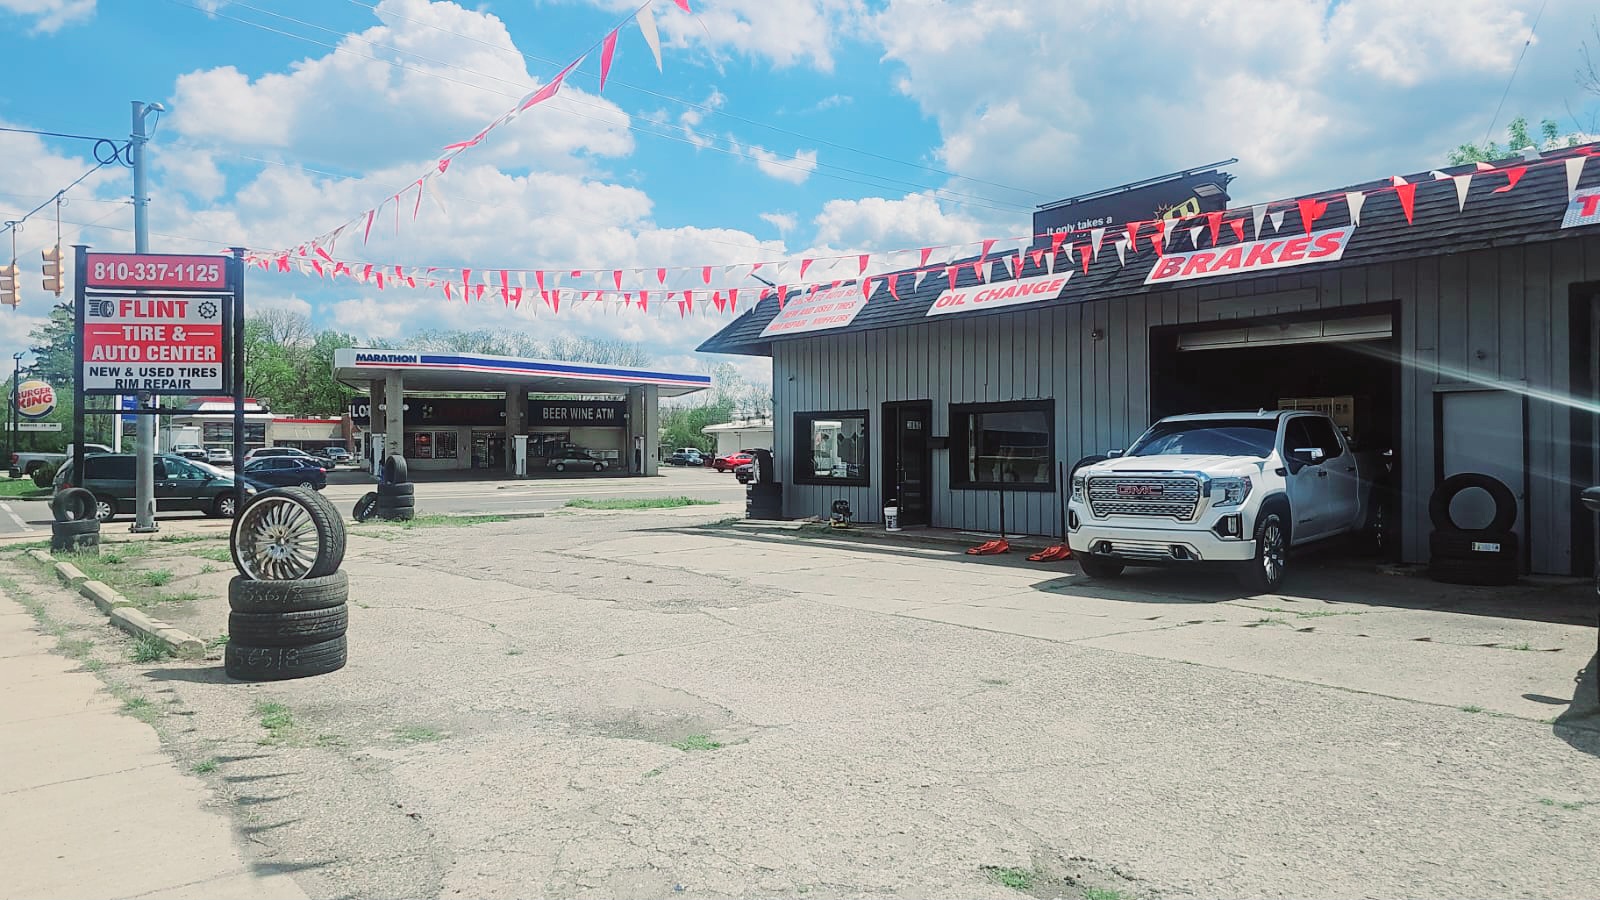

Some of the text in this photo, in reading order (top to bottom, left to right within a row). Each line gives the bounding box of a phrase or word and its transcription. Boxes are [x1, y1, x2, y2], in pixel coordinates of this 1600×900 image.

[1056, 223, 1076, 234] only
[1077, 217, 1104, 229] takes
[1106, 216, 1113, 224] a
[1151, 231, 1345, 280] BRAKES
[94, 262, 219, 282] 810-337-1125
[935, 278, 1065, 308] OIL CHANGE
[119, 300, 189, 318] FLINT
[122, 326, 187, 341] TIRE &
[91, 345, 216, 361] AUTO CENTER
[356, 354, 417, 363] MARATHON
[89, 367, 217, 378] NEW & USED TIRES
[115, 379, 191, 389] RIM REPAIR
[18, 394, 53, 409] KING
[542, 407, 615, 420] BEER WINE ATM
[1118, 485, 1162, 495] GMC
